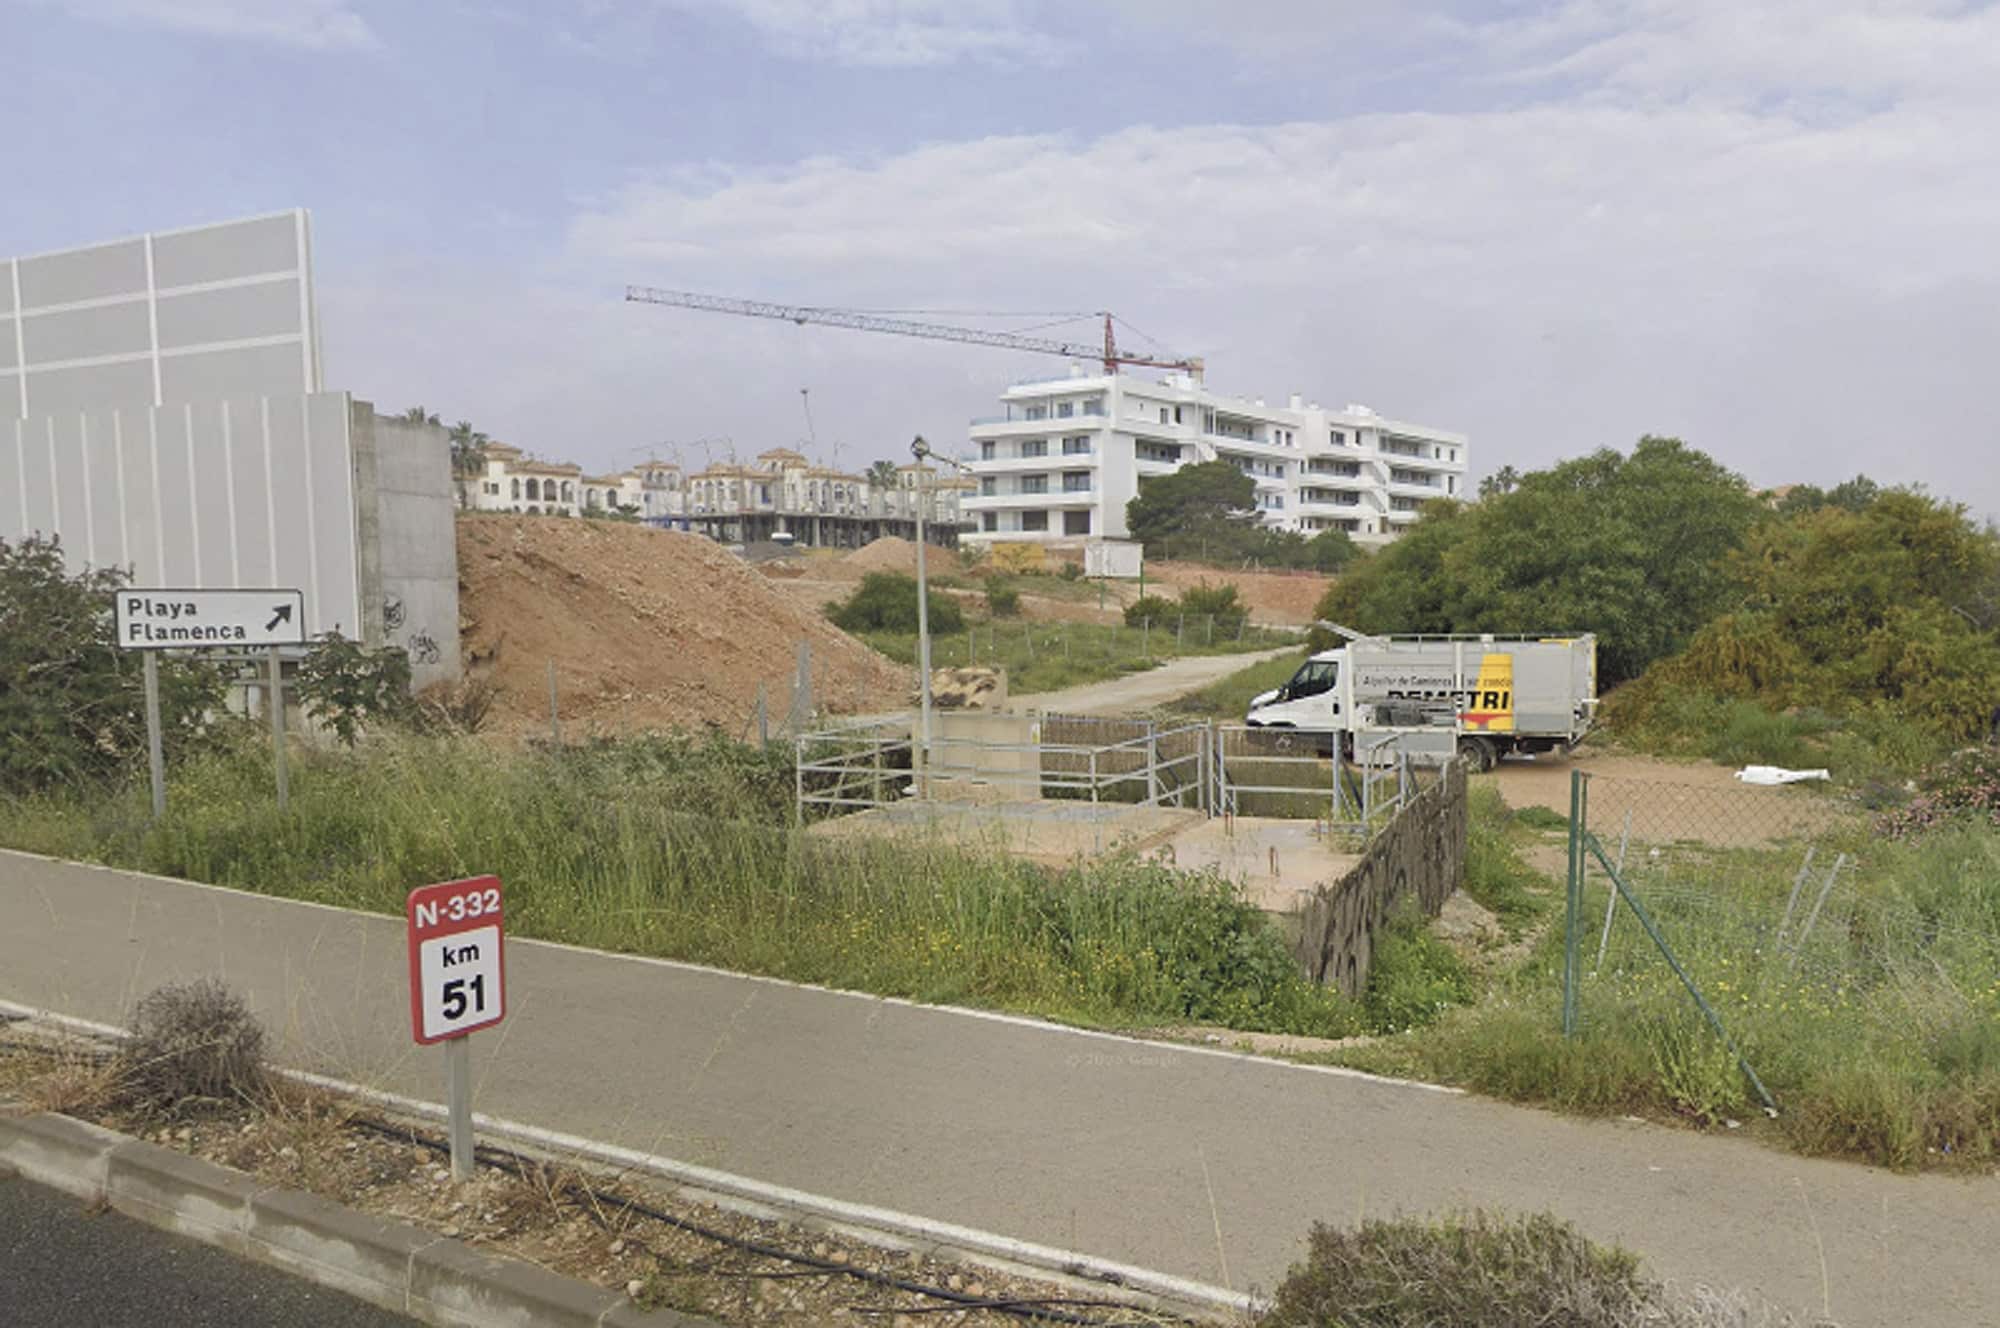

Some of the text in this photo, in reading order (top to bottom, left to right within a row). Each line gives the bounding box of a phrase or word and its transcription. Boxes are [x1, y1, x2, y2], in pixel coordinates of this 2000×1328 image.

[128, 598, 197, 619] Playa
[129, 623, 246, 641] Flamenca
[415, 888, 500, 929] N-332
[442, 943, 480, 968] km
[442, 974, 485, 1021] 51
